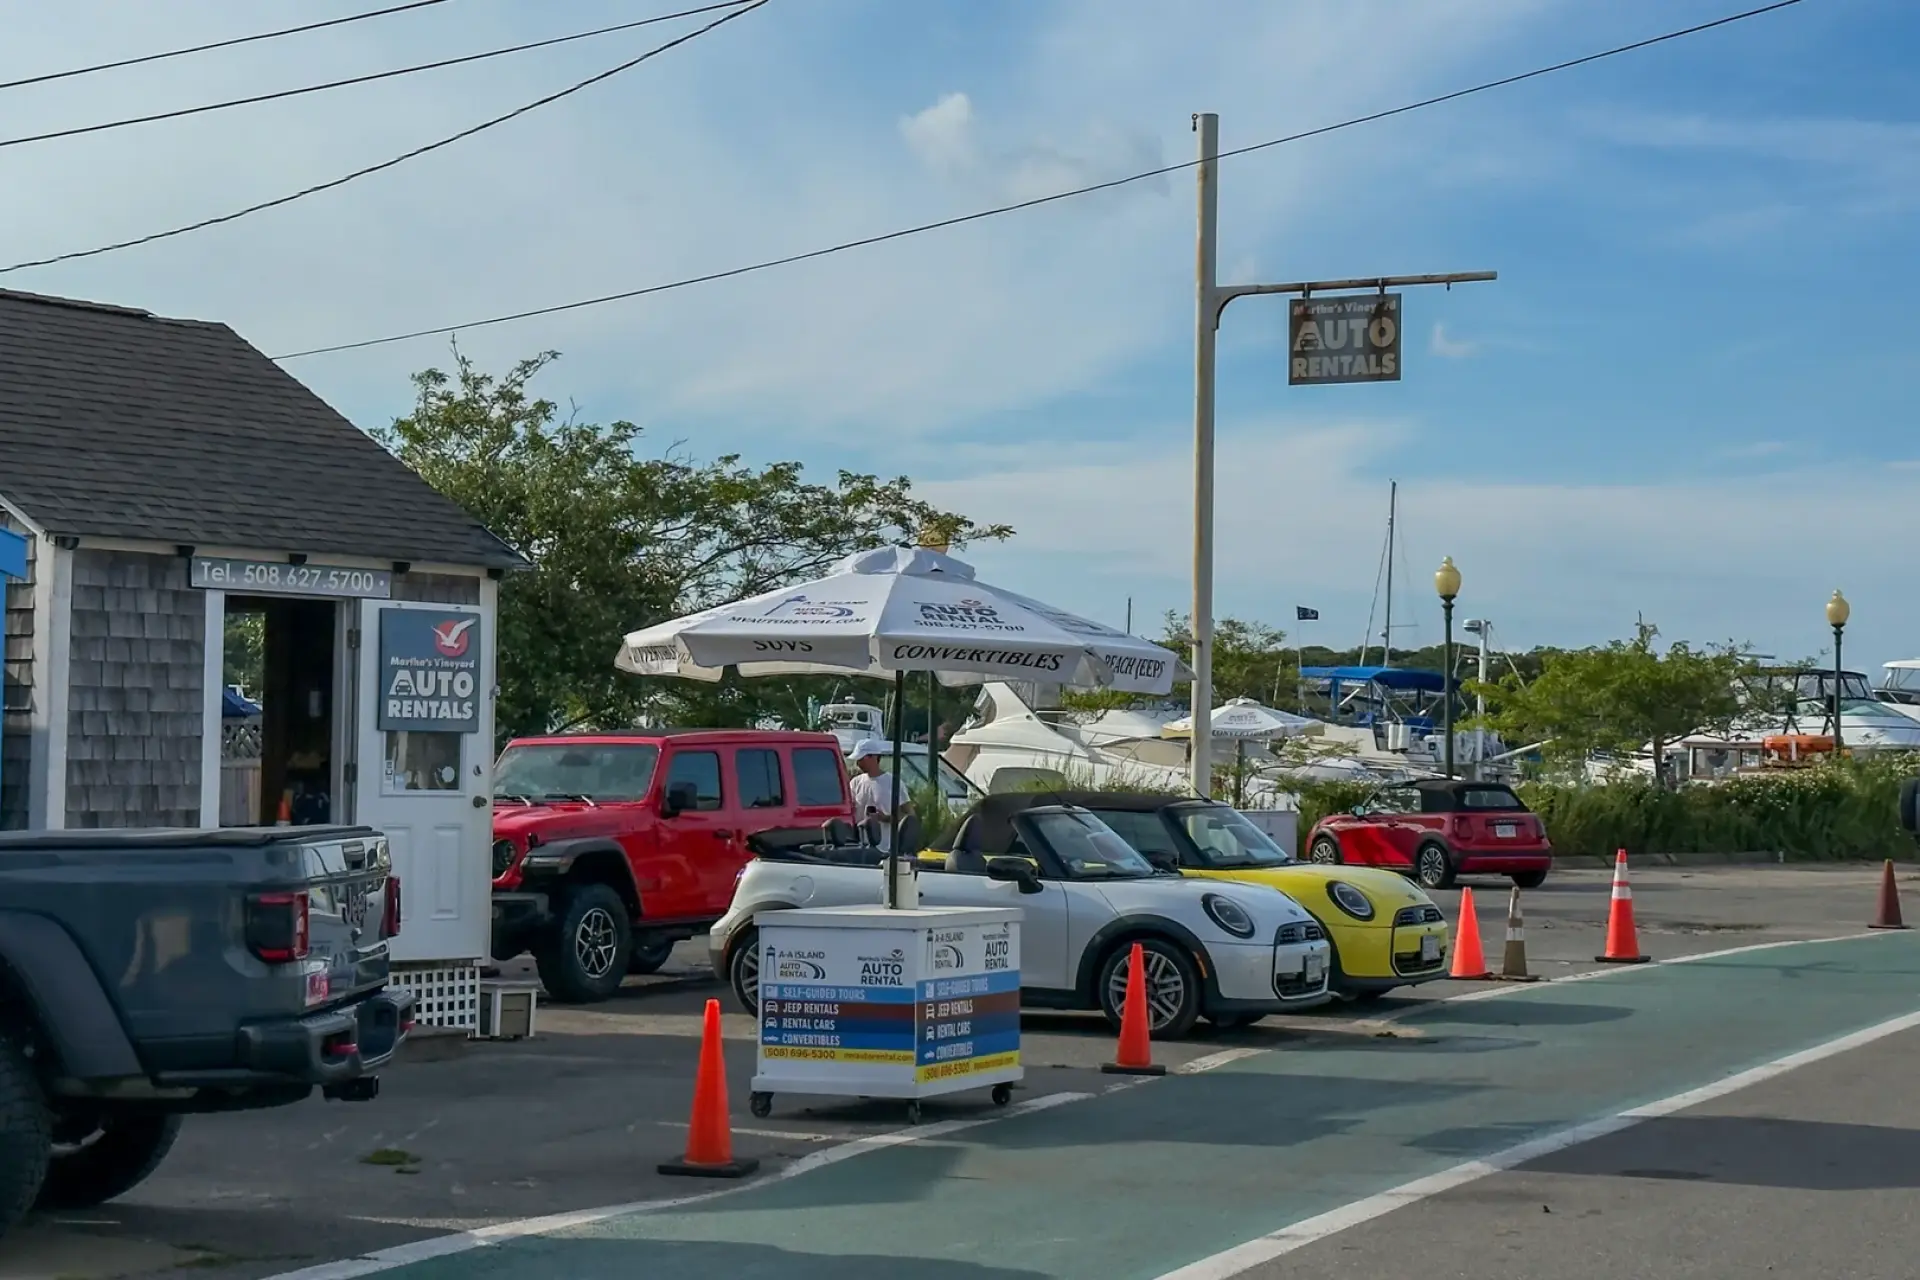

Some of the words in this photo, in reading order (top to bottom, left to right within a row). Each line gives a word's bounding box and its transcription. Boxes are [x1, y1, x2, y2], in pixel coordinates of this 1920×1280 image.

[1293, 316, 1396, 351] AUTO
[1292, 353, 1396, 378] RENTALS
[201, 561, 236, 583] Tel.
[244, 564, 374, 592] 508.627.5700
[920, 605, 998, 616] AUTO
[921, 613, 1005, 623] RENTAL
[753, 640, 813, 652] SUVS
[391, 656, 432, 667] Martha's
[434, 658, 475, 669] Vineyard
[893, 644, 1064, 671] CONVERTIBLES
[1134, 659, 1166, 681] JEEPS
[388, 669, 474, 698] AUTO
[387, 700, 473, 719] RENTALS
[795, 951, 825, 959] ISLAND
[985, 941, 1009, 957] AUTO
[862, 963, 903, 975] AUTO
[984, 957, 1009, 971] RENTAL
[780, 970, 807, 978] RENTAL
[861, 975, 903, 986] RENTAL
[783, 986, 837, 999] SELF-GUIDED
[838, 989, 866, 1000] TOURS
[782, 1002, 802, 1014] JEEP
[804, 1003, 839, 1015] RENTALS
[937, 1003, 949, 1017] JEEP
[782, 1018, 812, 1030] RENTAL
[813, 1019, 836, 1031] CARS
[957, 1020, 971, 1036] CARS
[782, 1033, 841, 1046] CONVERTIBLES
[790, 1048, 836, 1061] 696-5300
